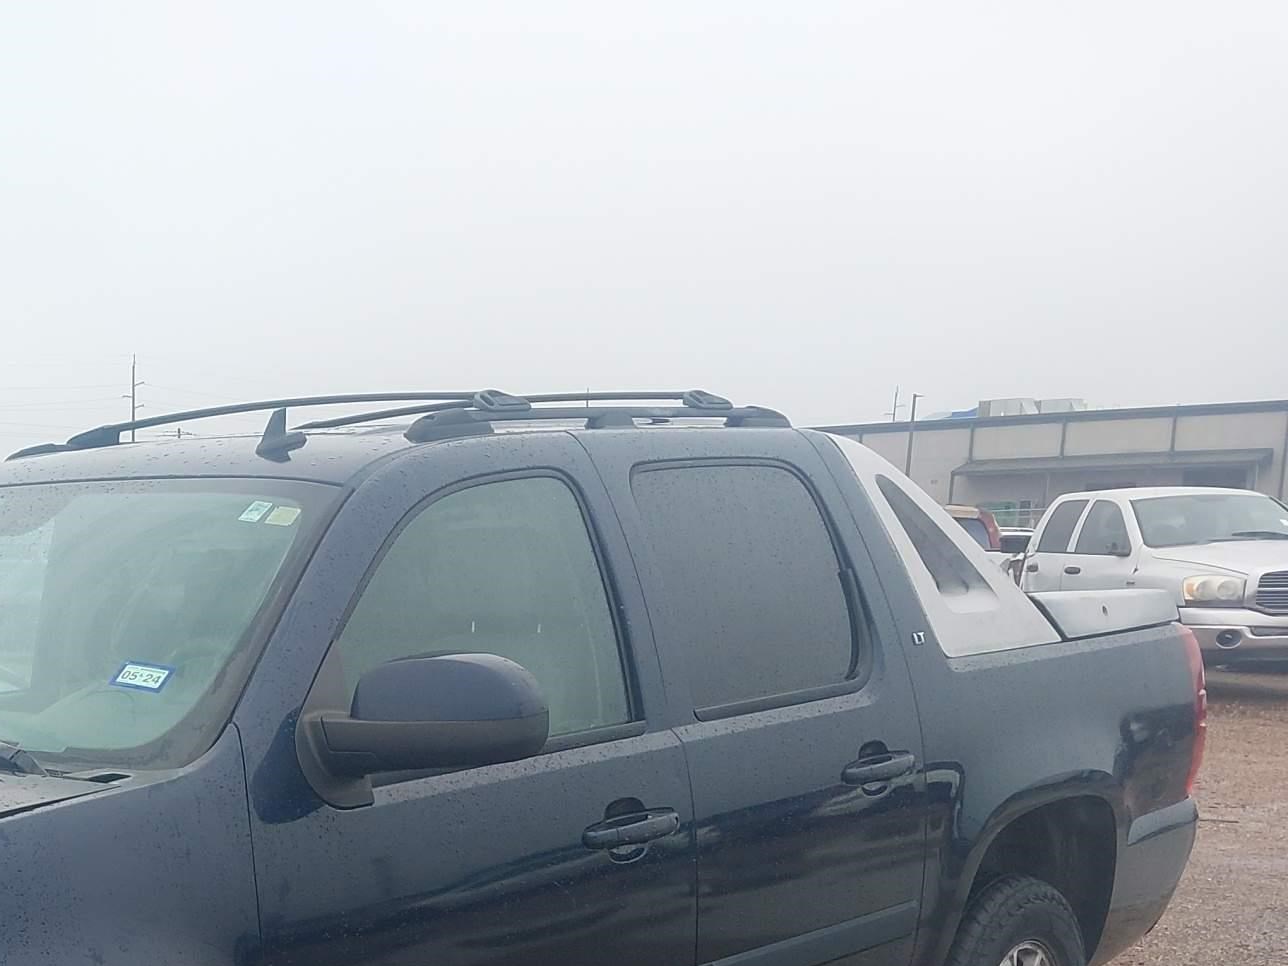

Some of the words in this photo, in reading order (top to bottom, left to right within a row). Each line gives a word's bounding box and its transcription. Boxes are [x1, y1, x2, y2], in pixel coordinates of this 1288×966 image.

[912, 631, 925, 645] LT
[121, 670, 139, 681] 05
[142, 673, 162, 685] 24
